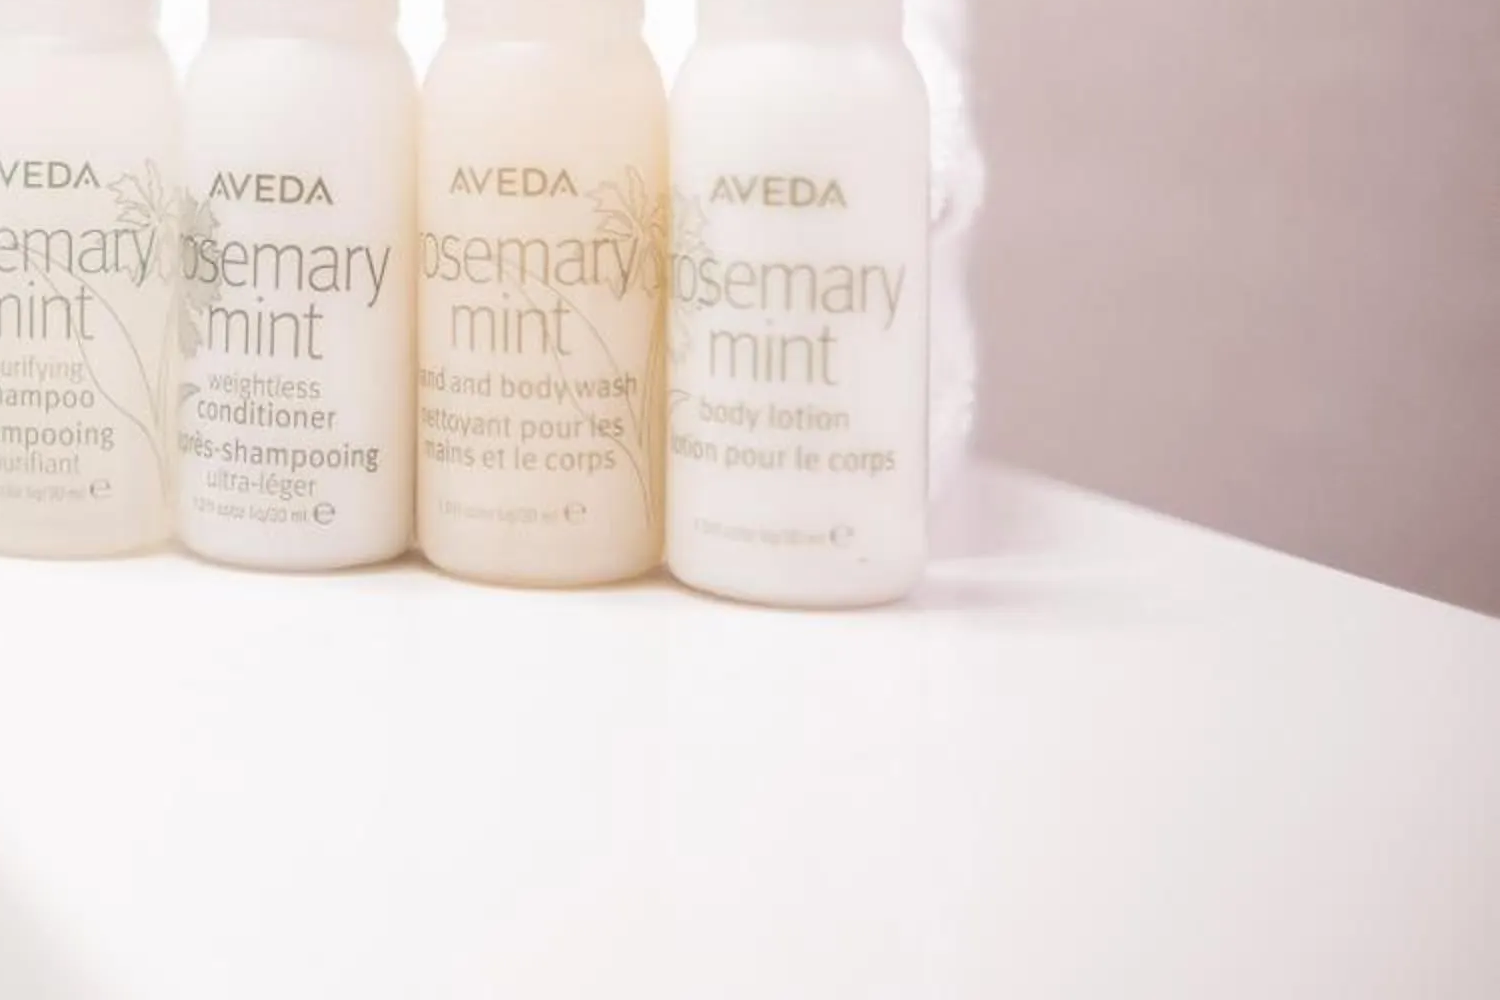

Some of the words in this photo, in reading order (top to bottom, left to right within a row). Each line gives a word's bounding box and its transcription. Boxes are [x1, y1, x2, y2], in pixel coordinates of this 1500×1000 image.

[208, 171, 334, 205] AVEDA
[450, 167, 578, 198] AVEDA
[709, 175, 848, 208] AVEDA
[181, 232, 391, 308] osemary
[421, 231, 639, 301] osemary
[207, 295, 324, 360] mint
[451, 292, 573, 356] mint
[708, 318, 838, 385] mint
[208, 373, 323, 400] weightless
[420, 366, 446, 391] and
[451, 371, 492, 397] and
[500, 373, 569, 405] body
[575, 371, 638, 399] wash
[197, 398, 338, 431] conditioner
[421, 406, 511, 438] ettoyant
[521, 418, 582, 442] pour
[590, 411, 625, 438] les
[698, 395, 760, 432] body
[768, 403, 850, 431] lotion
[482, 448, 505, 470] et
[515, 446, 539, 471] le
[544, 448, 617, 475] corps
[725, 445, 786, 470] pour
[794, 444, 821, 471] le
[828, 449, 897, 479] corps
[206, 468, 318, 501] ultra-léger
